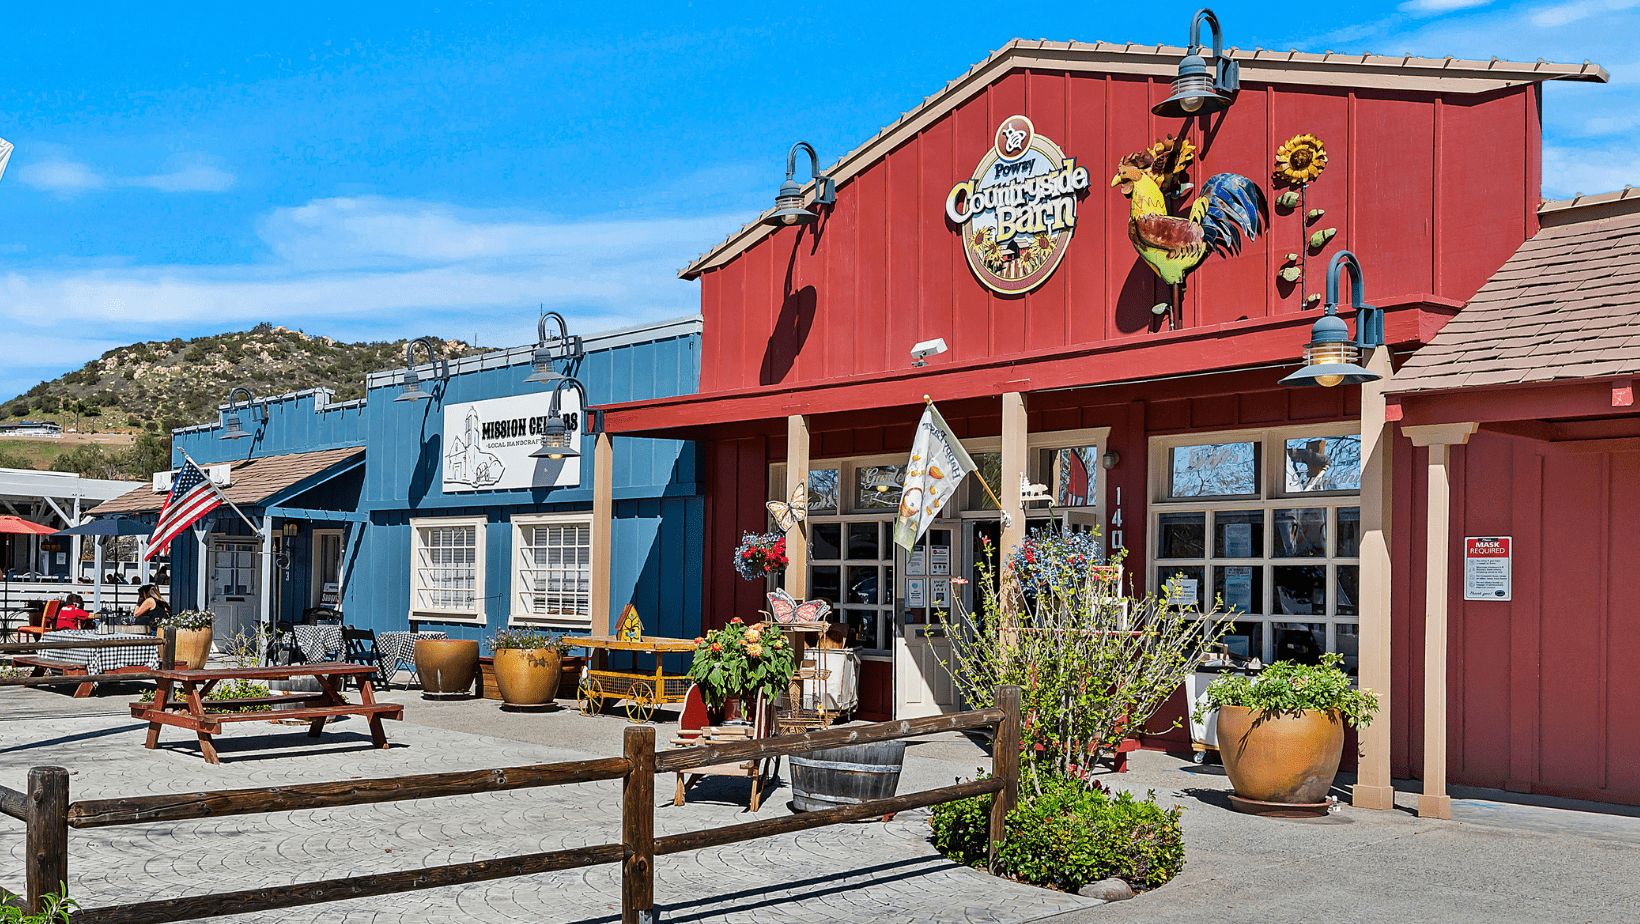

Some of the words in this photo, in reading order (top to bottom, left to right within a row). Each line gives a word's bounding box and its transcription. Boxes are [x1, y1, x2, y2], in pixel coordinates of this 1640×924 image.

[994, 158, 1036, 180] Poway
[945, 155, 1091, 224] Countryside
[996, 196, 1077, 242] Barn
[482, 418, 526, 440] MISSION
[529, 412, 578, 436] CERS
[507, 439, 542, 448] HANDCRAF
[1185, 447, 1239, 473] Gifts
[864, 467, 906, 490] Garde
[1469, 547, 1506, 555] REQUIRED
